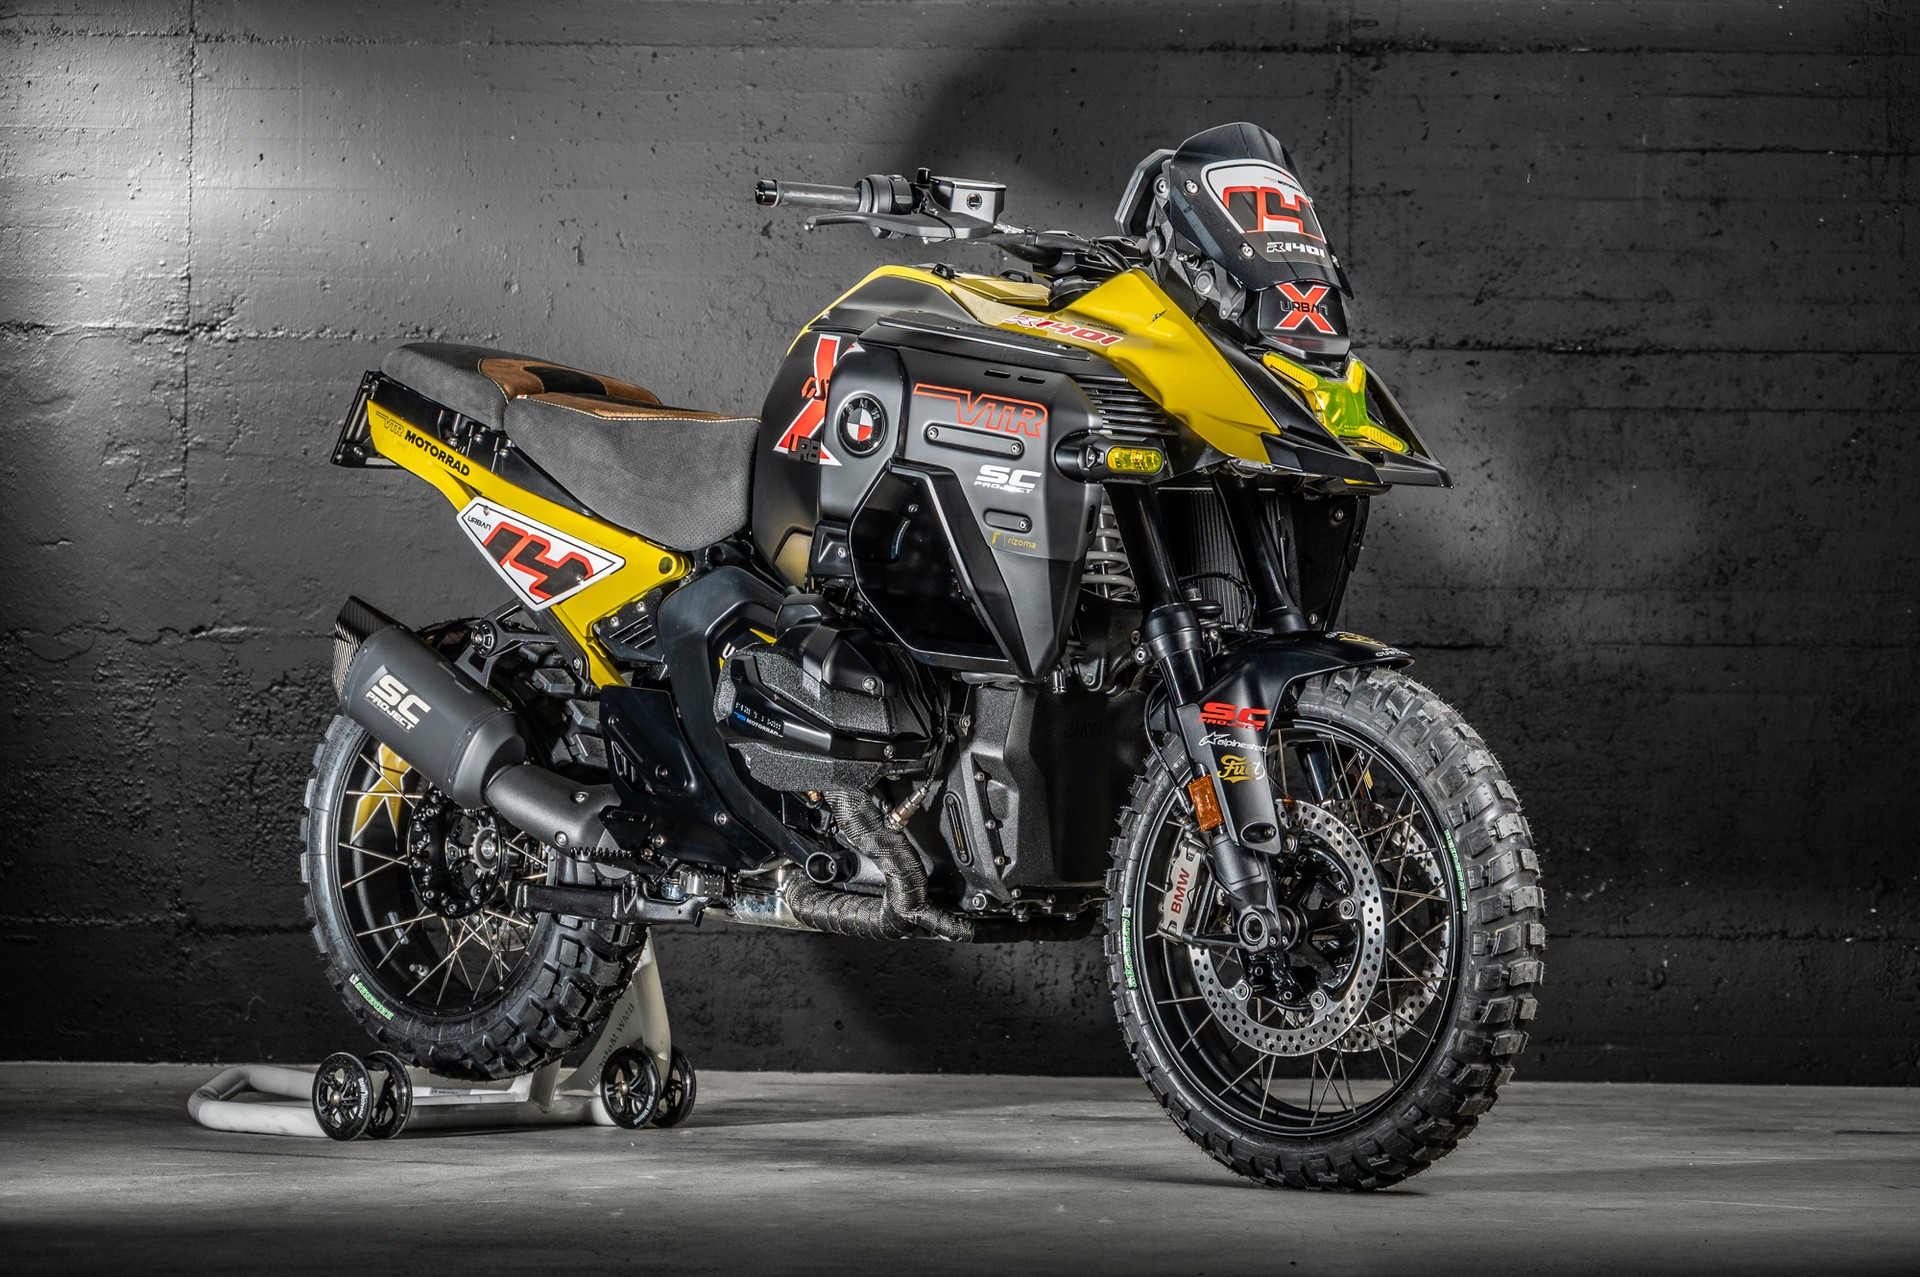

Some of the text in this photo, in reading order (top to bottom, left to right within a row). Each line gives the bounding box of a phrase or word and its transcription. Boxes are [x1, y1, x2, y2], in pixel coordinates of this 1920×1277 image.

[913, 382, 1049, 439] VTR
[404, 429, 470, 477] MOTORRAD
[973, 480, 1034, 494] PROJECT
[975, 463, 1043, 490] SC
[467, 515, 492, 532] URBAN
[1007, 536, 1037, 549] rizoma
[365, 690, 415, 730] PROJECT
[370, 674, 432, 725] SC
[746, 717, 779, 736] MOTORRAD
[1197, 717, 1264, 732] PROJECT
[1200, 701, 1271, 727] SC
[1217, 738, 1267, 753] alpinestars
[1216, 754, 1266, 784] Fuel
[1170, 867, 1190, 915] BMW
